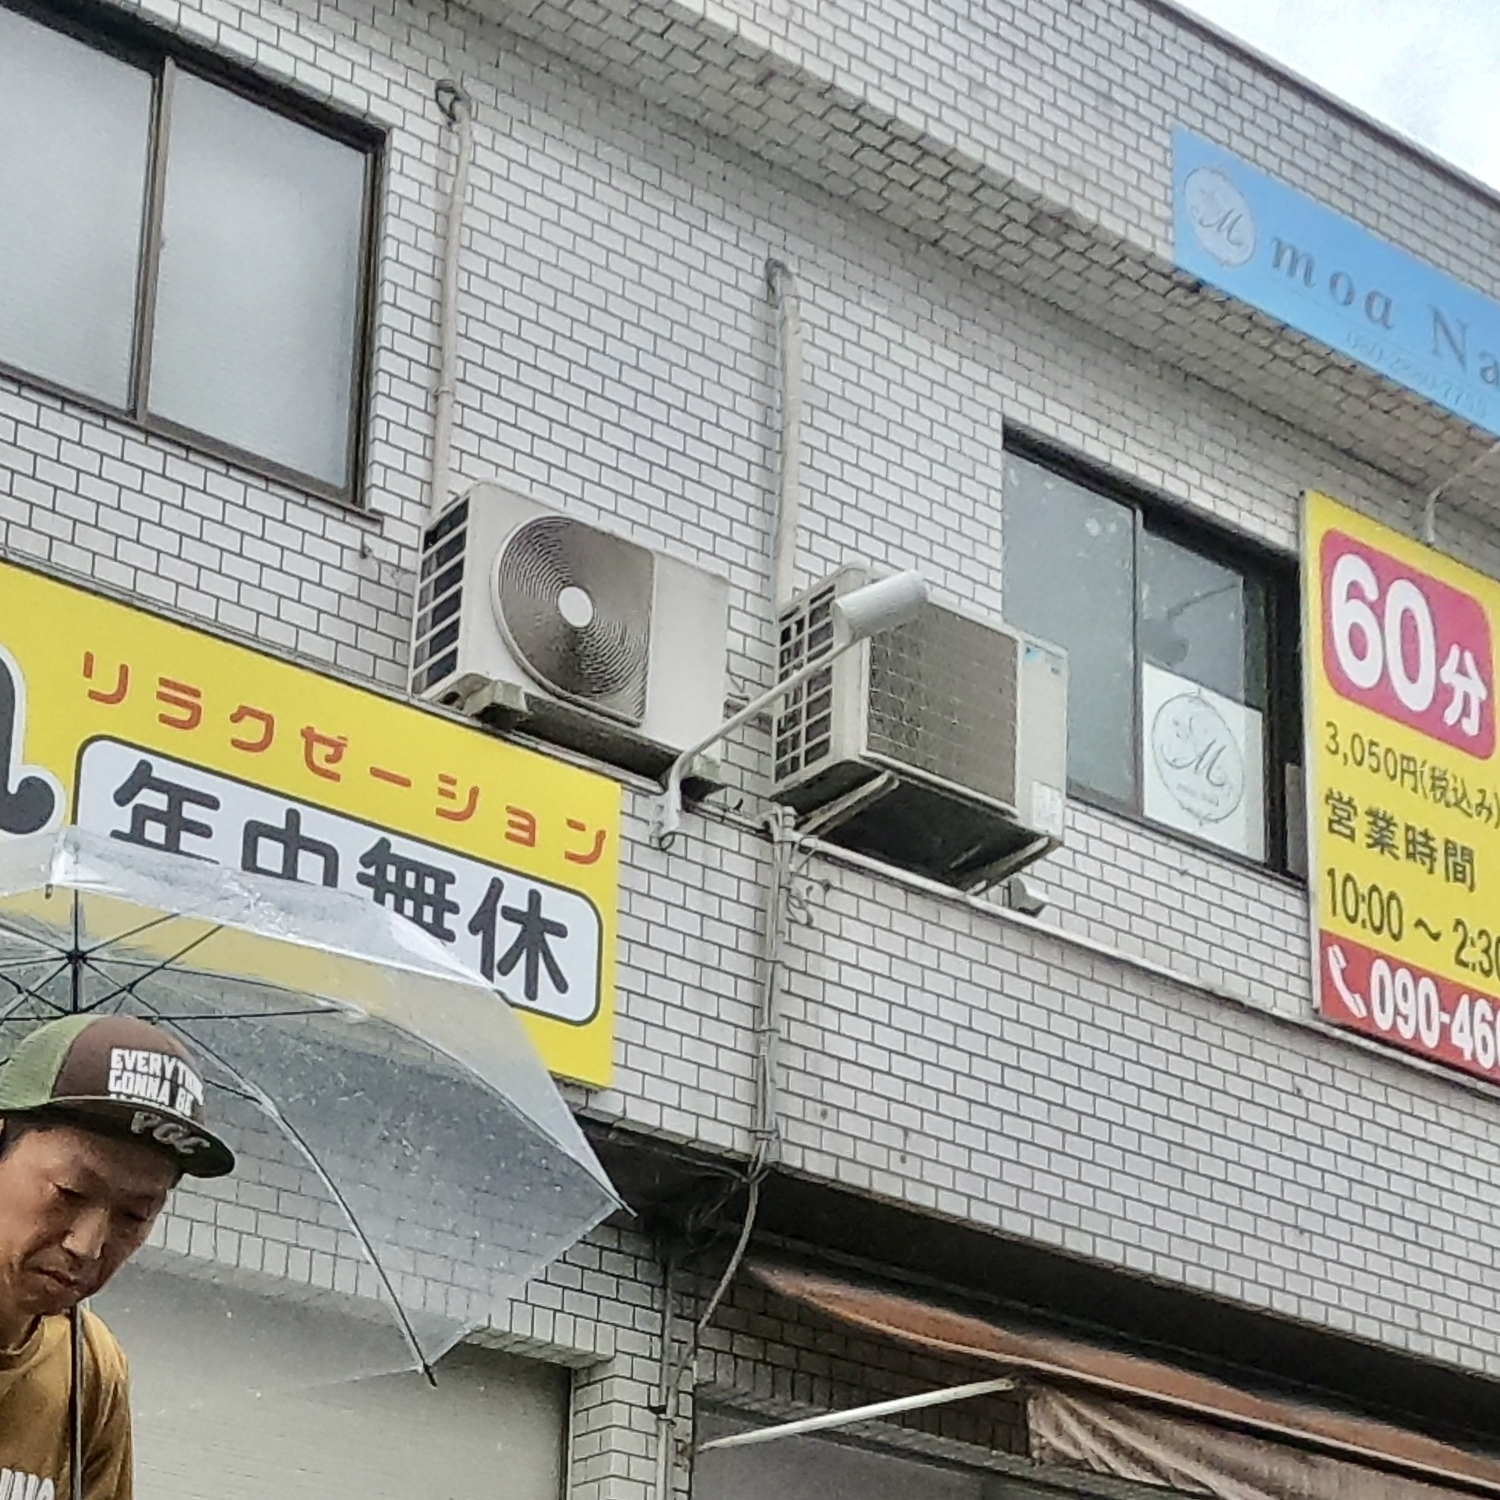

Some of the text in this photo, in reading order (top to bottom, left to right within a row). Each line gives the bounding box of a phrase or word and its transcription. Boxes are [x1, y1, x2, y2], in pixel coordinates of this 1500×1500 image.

[1269, 236, 1394, 330] moa
[1331, 554, 1487, 737] 60分
[83, 651, 606, 865] リラクゼーション
[109, 758, 569, 1001] 年中無休
[1324, 787, 1475, 893] 営業時間
[1327, 867, 1403, 942] 10:00
[1452, 918, 1500, 980] 2:3
[1370, 959, 1500, 1069] 090-46
[108, 1068, 171, 1106] GONNA
